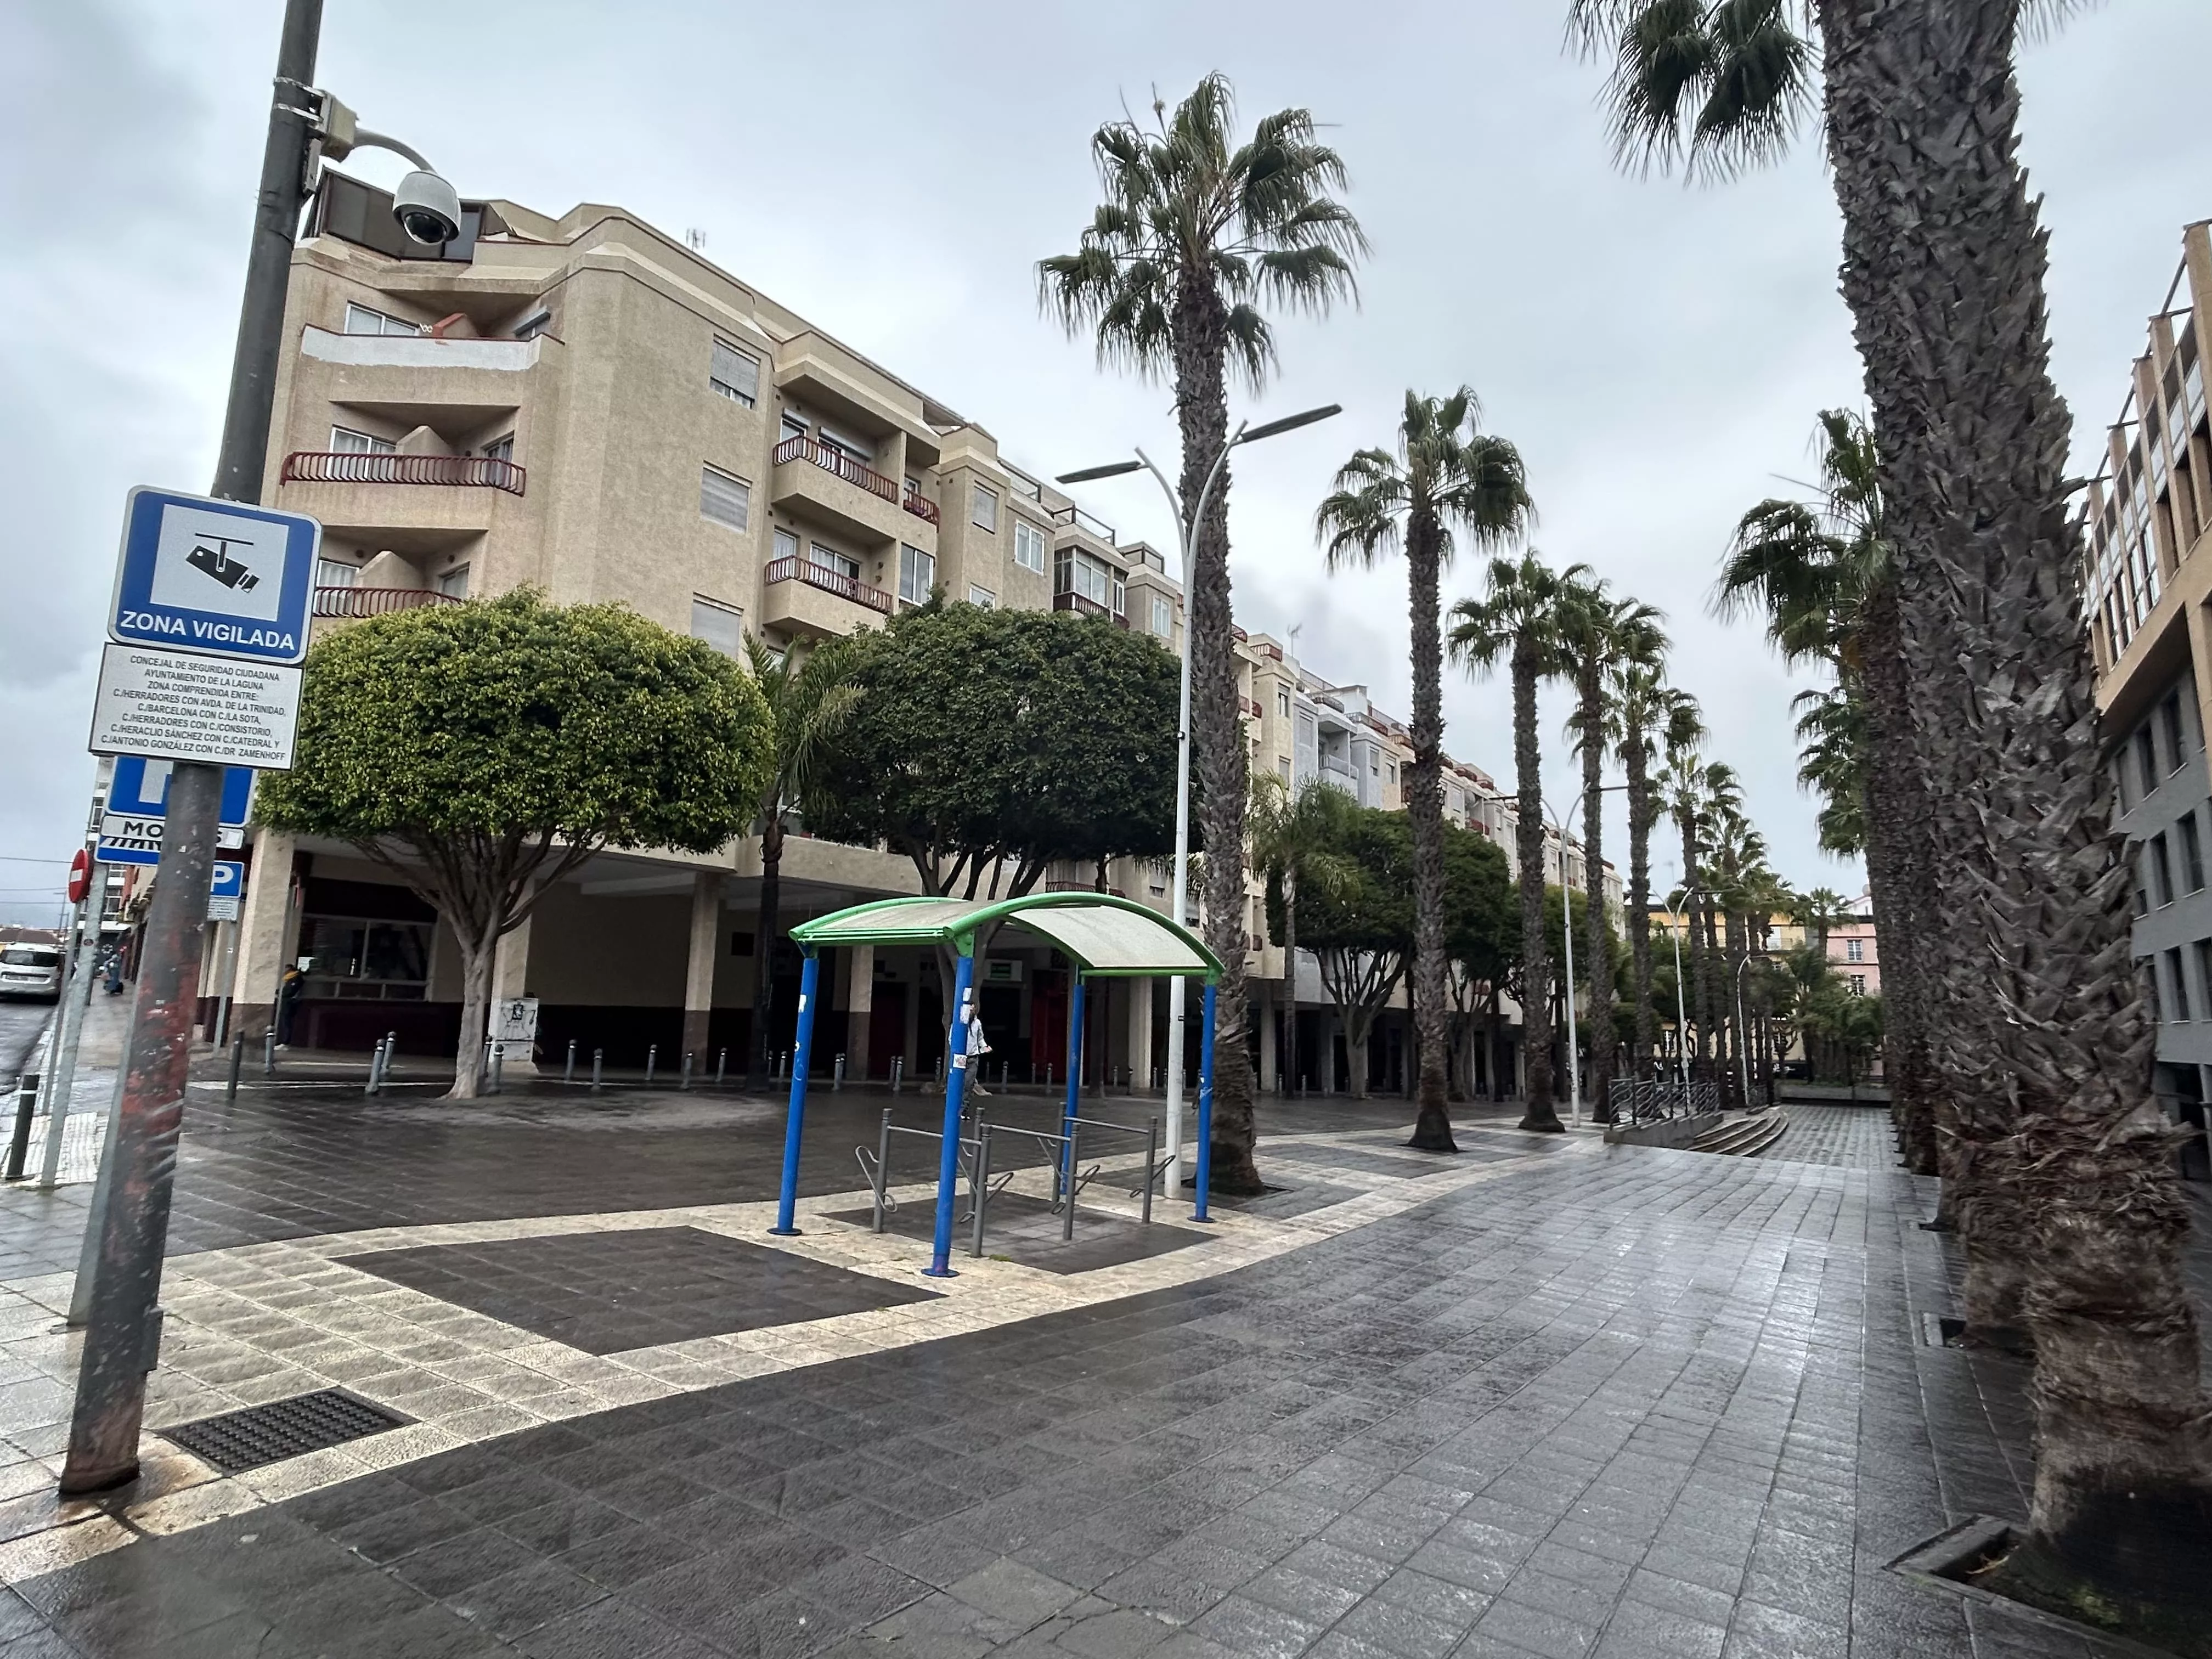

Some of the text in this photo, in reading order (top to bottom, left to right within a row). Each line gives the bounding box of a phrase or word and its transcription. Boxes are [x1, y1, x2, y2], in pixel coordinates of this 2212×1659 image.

[120, 610, 295, 651] ZONA VIGILADA
[130, 655, 280, 681] CONCEJAL DE SEGURIDAD CIUDADANA
[144, 668, 263, 690] AYUNTAMIENTO DE LA LAGUNA
[148, 680, 170, 690] ZONA
[171, 684, 229, 698] COMPRENDIDA
[113, 688, 286, 716] C./HERRADORES CON AVDA. DE LA TRINIDAD,
[122, 713, 188, 727] C./HERRADORES
[190, 720, 207, 730] CON
[138, 703, 198, 716] C./BARCELONA
[199, 710, 217, 719] CON
[239, 714, 261, 725] SOTA,
[101, 735, 149, 747] C./ANTONIO
[150, 739, 194, 752] GONZÁLEZ
[195, 744, 213, 753] CON
[238, 748, 286, 760] ZAMENHOFF
[165, 729, 203, 741] SÁNCHEZ
[204, 733, 221, 742] CON
[223, 735, 273, 748] C./CATEDRAL
[210, 865, 234, 891] P
